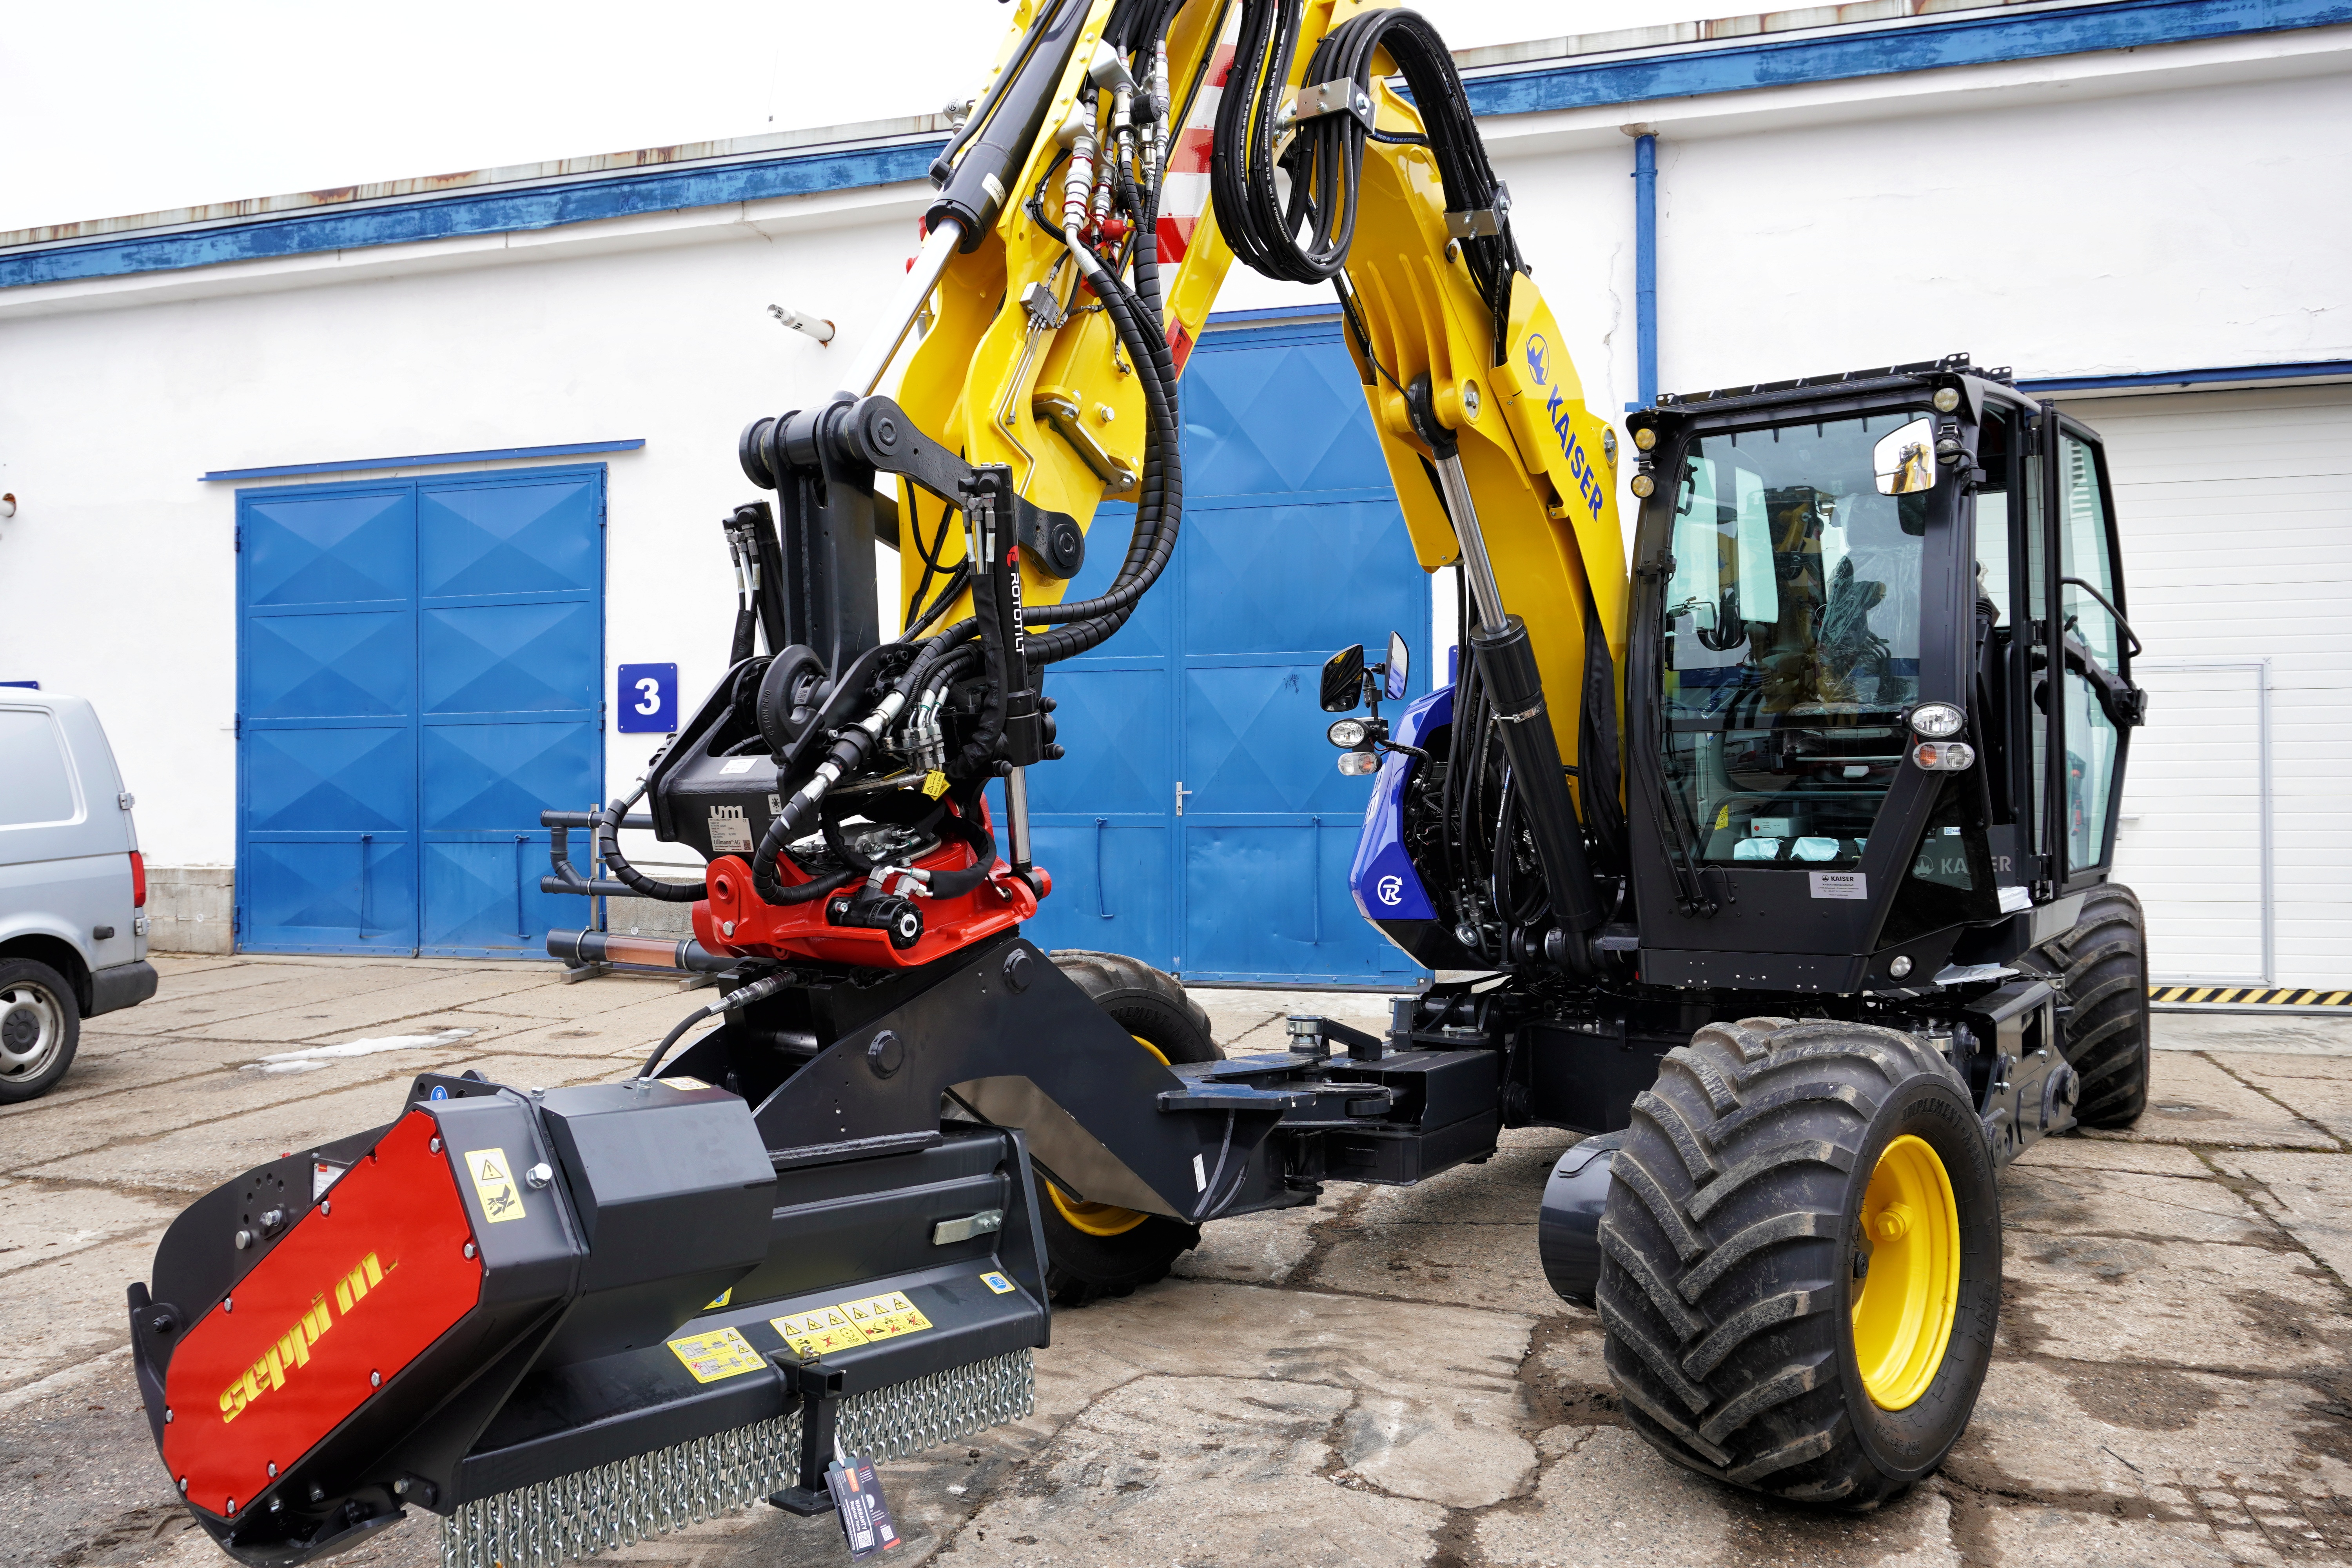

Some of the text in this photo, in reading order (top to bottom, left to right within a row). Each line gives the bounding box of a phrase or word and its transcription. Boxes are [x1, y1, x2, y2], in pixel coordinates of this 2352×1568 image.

[1272, 85, 1284, 118] SEMPERSHIELD
[1452, 92, 1465, 121] SEMPERSHIELD
[1273, 206, 1290, 243] SEMPERSHIELD
[1546, 383, 1603, 522] KAISER
[1011, 572, 1025, 656] ROTOTILT
[635, 678, 661, 715] 3
[762, 709, 771, 724] TON
[220, 1290, 332, 1423] seppi
[842, 1507, 857, 1550] www.seppi.com/warranty
[849, 1500, 858, 1521] Register
[854, 1499, 867, 1530] WARRANTY
